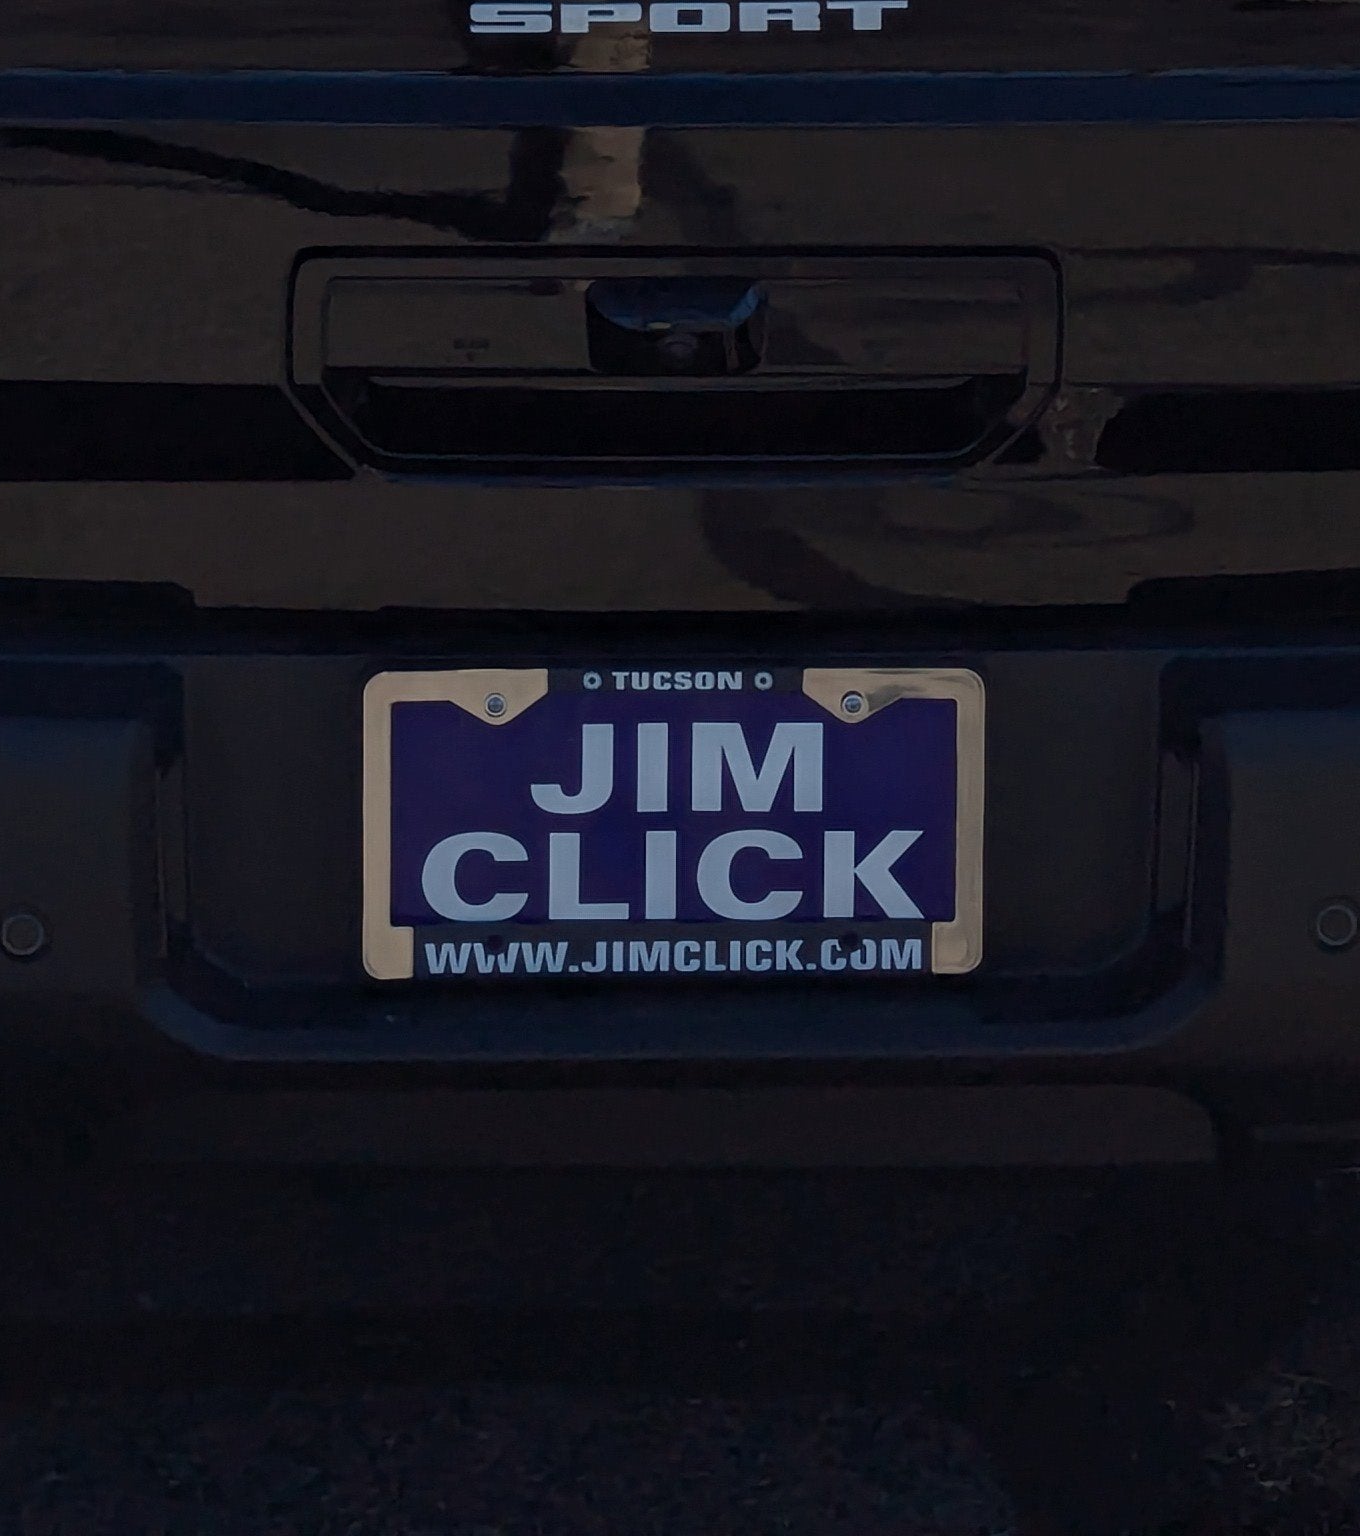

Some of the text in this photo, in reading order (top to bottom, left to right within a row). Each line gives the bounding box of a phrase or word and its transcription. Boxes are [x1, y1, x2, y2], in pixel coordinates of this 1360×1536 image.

[469, 0, 909, 34] SPORT
[611, 670, 744, 691] TUCSON
[530, 721, 825, 816] JIM
[420, 828, 926, 922] CLICK
[424, 937, 923, 975] WWW.JIMCLICK.COM
